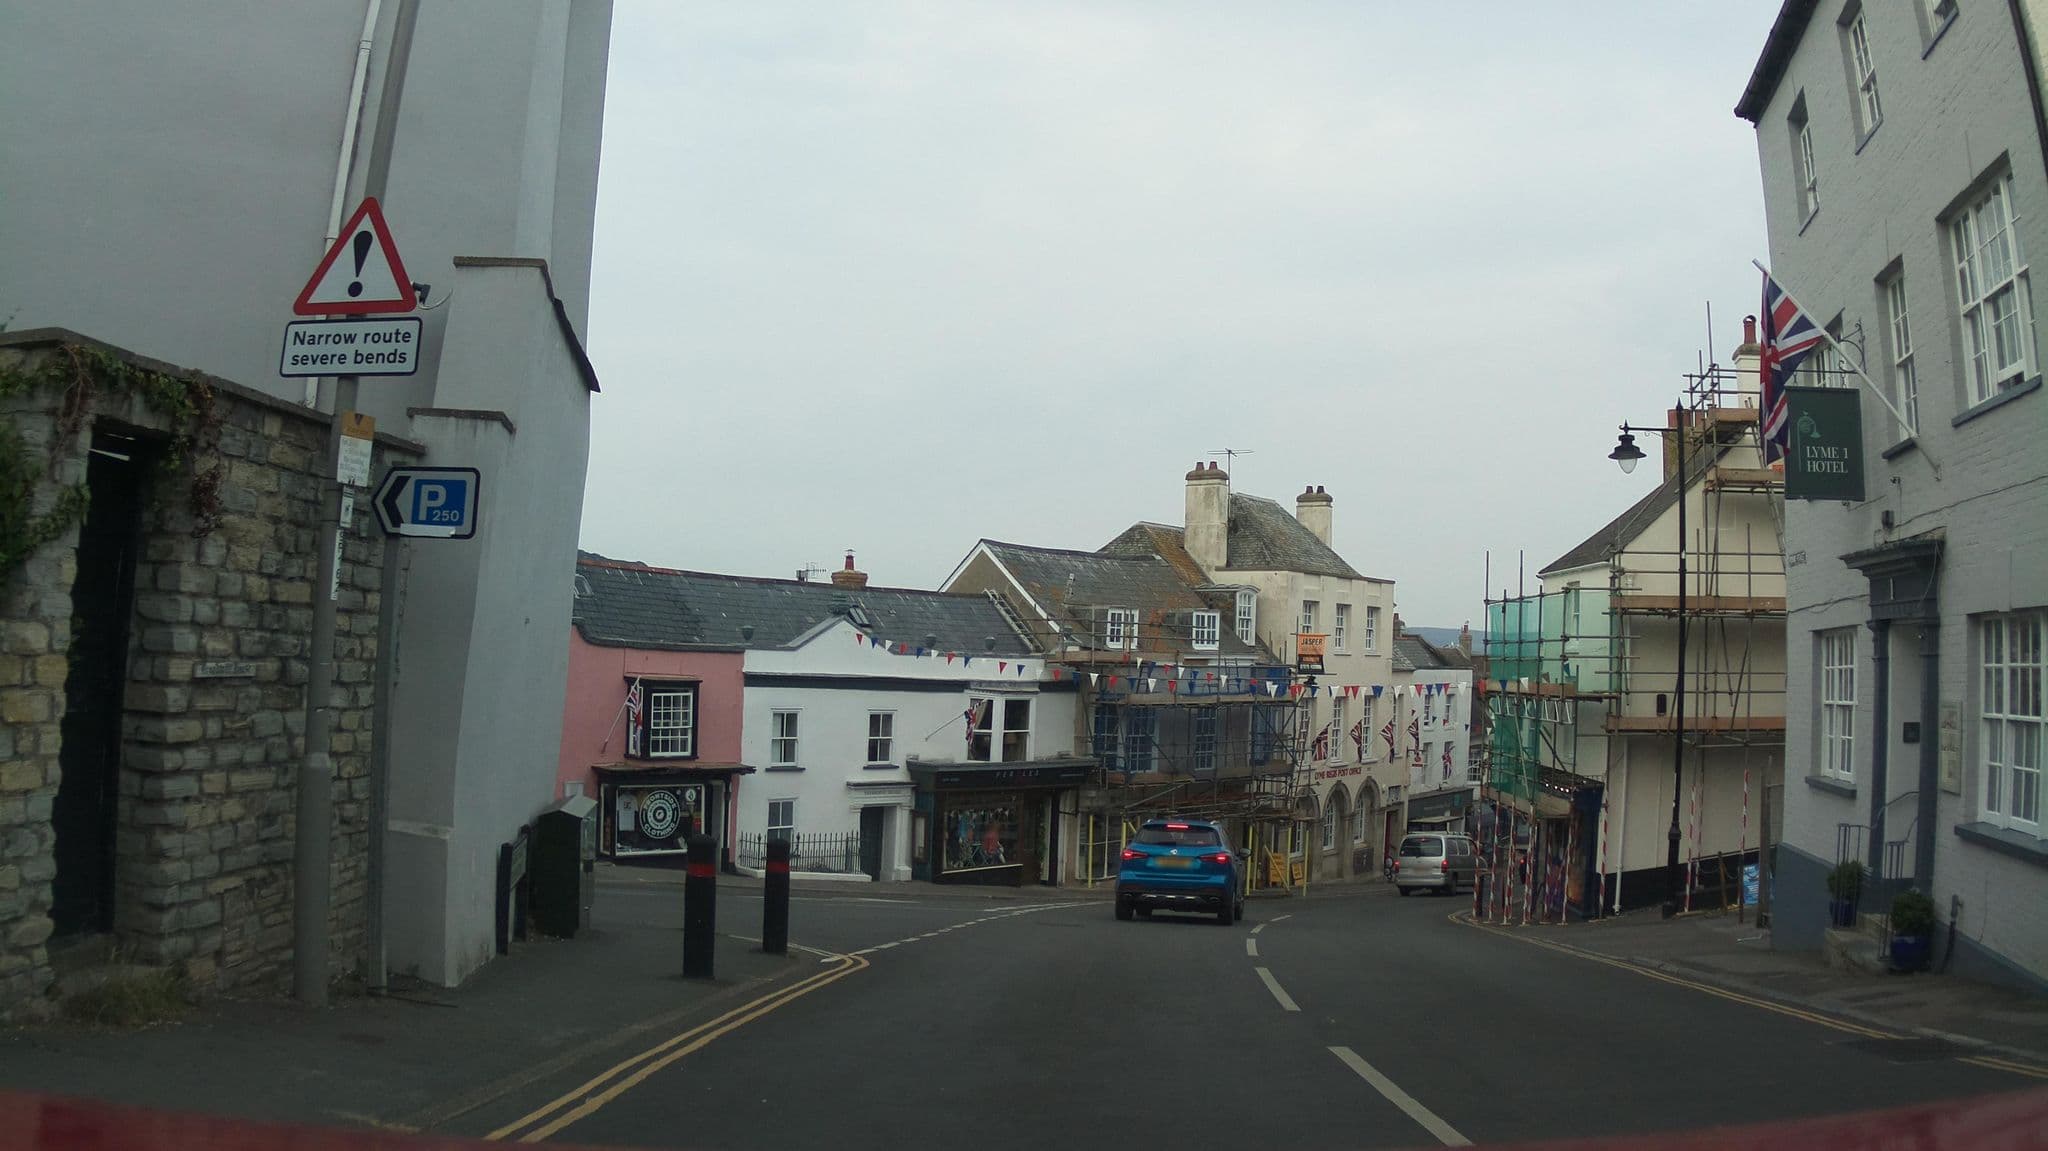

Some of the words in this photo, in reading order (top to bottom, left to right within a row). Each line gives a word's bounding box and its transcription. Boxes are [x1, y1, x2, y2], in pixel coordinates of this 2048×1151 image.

[293, 331, 357, 346] Narrow
[364, 328, 412, 344] route
[291, 353, 347, 366] severe
[354, 349, 407, 364] bends
[1806, 446, 1839, 459] LYME
[1843, 447, 1848, 459] 1
[1807, 460, 1848, 473] HOTEL
[418, 484, 447, 521] P
[432, 509, 460, 522] 250
[1301, 638, 1323, 646] JASPER
[1338, 768, 1348, 777] POST
[643, 793, 677, 809] FRONTSIDE
[644, 823, 676, 836] CLOTHING
